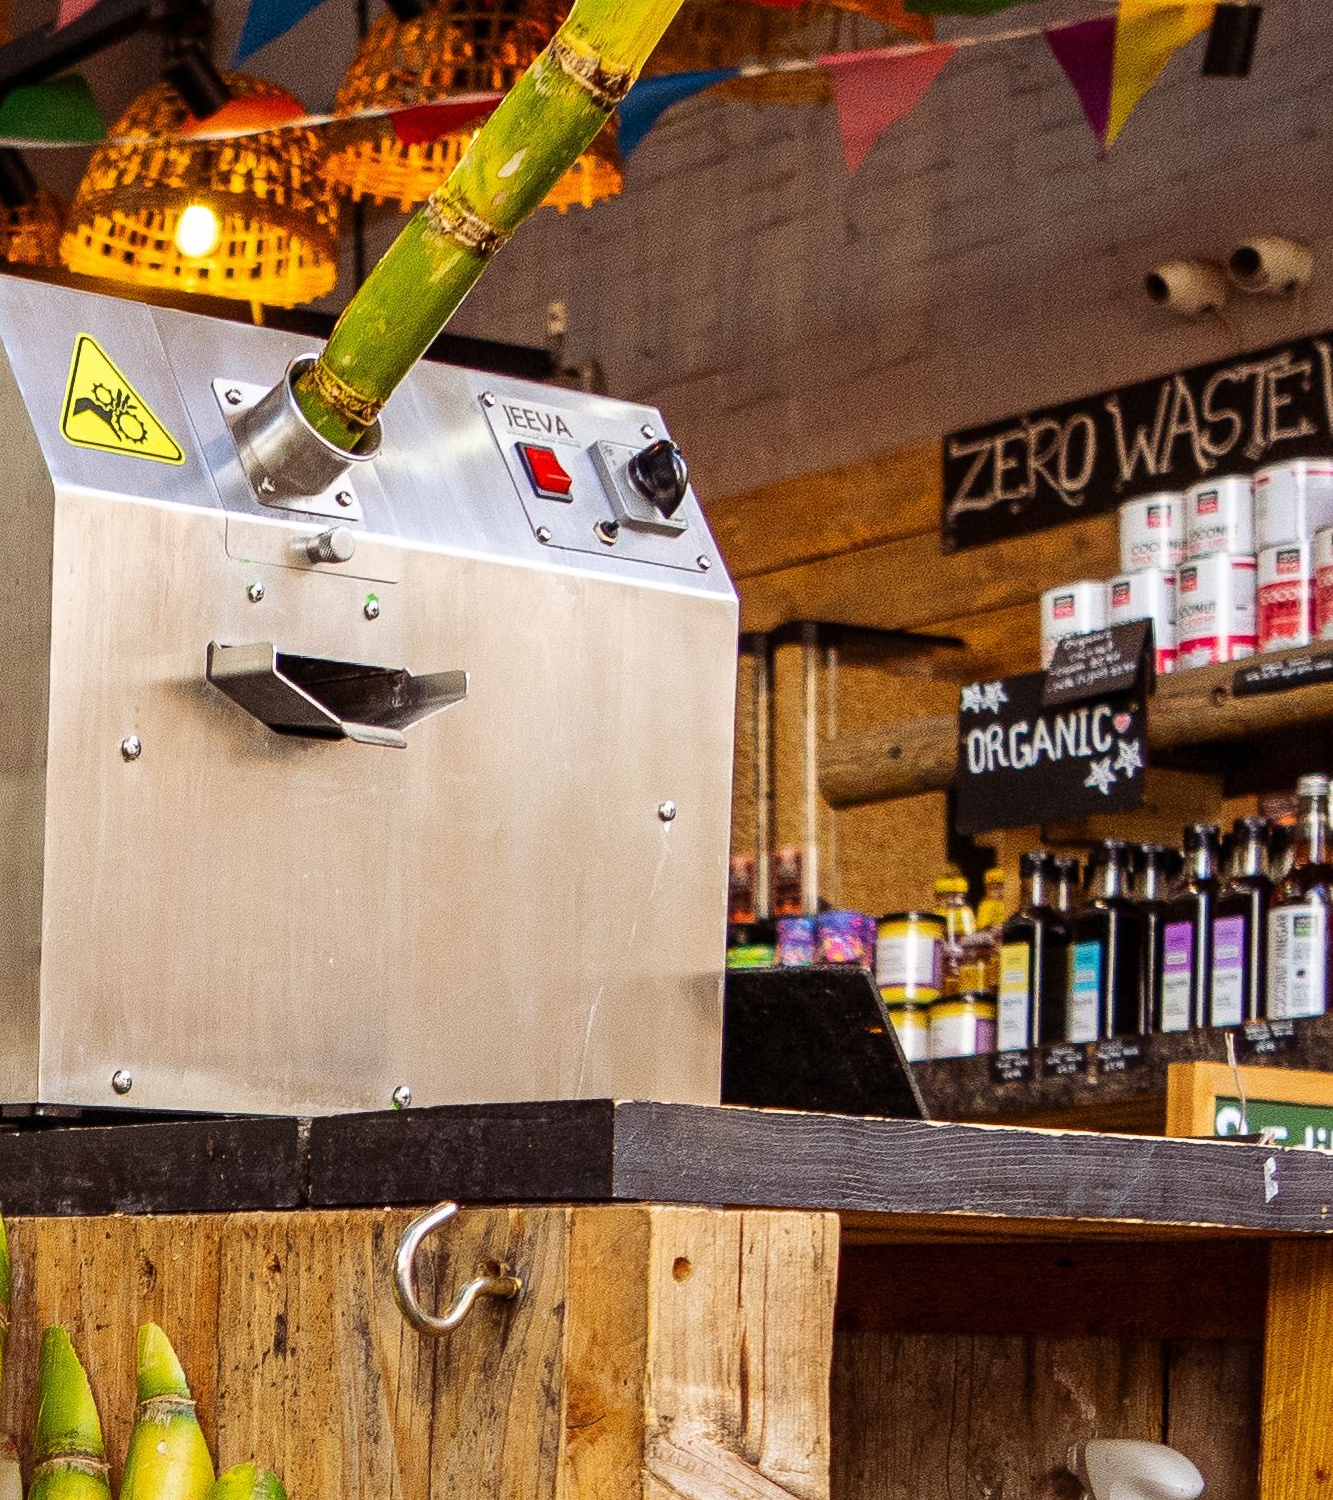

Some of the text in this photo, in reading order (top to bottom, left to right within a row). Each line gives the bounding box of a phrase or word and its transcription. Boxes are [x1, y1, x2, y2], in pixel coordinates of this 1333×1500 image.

[945, 412, 1097, 516] ZERO
[1104, 353, 1318, 491] WASTE
[966, 704, 1113, 775] ORGANIC
